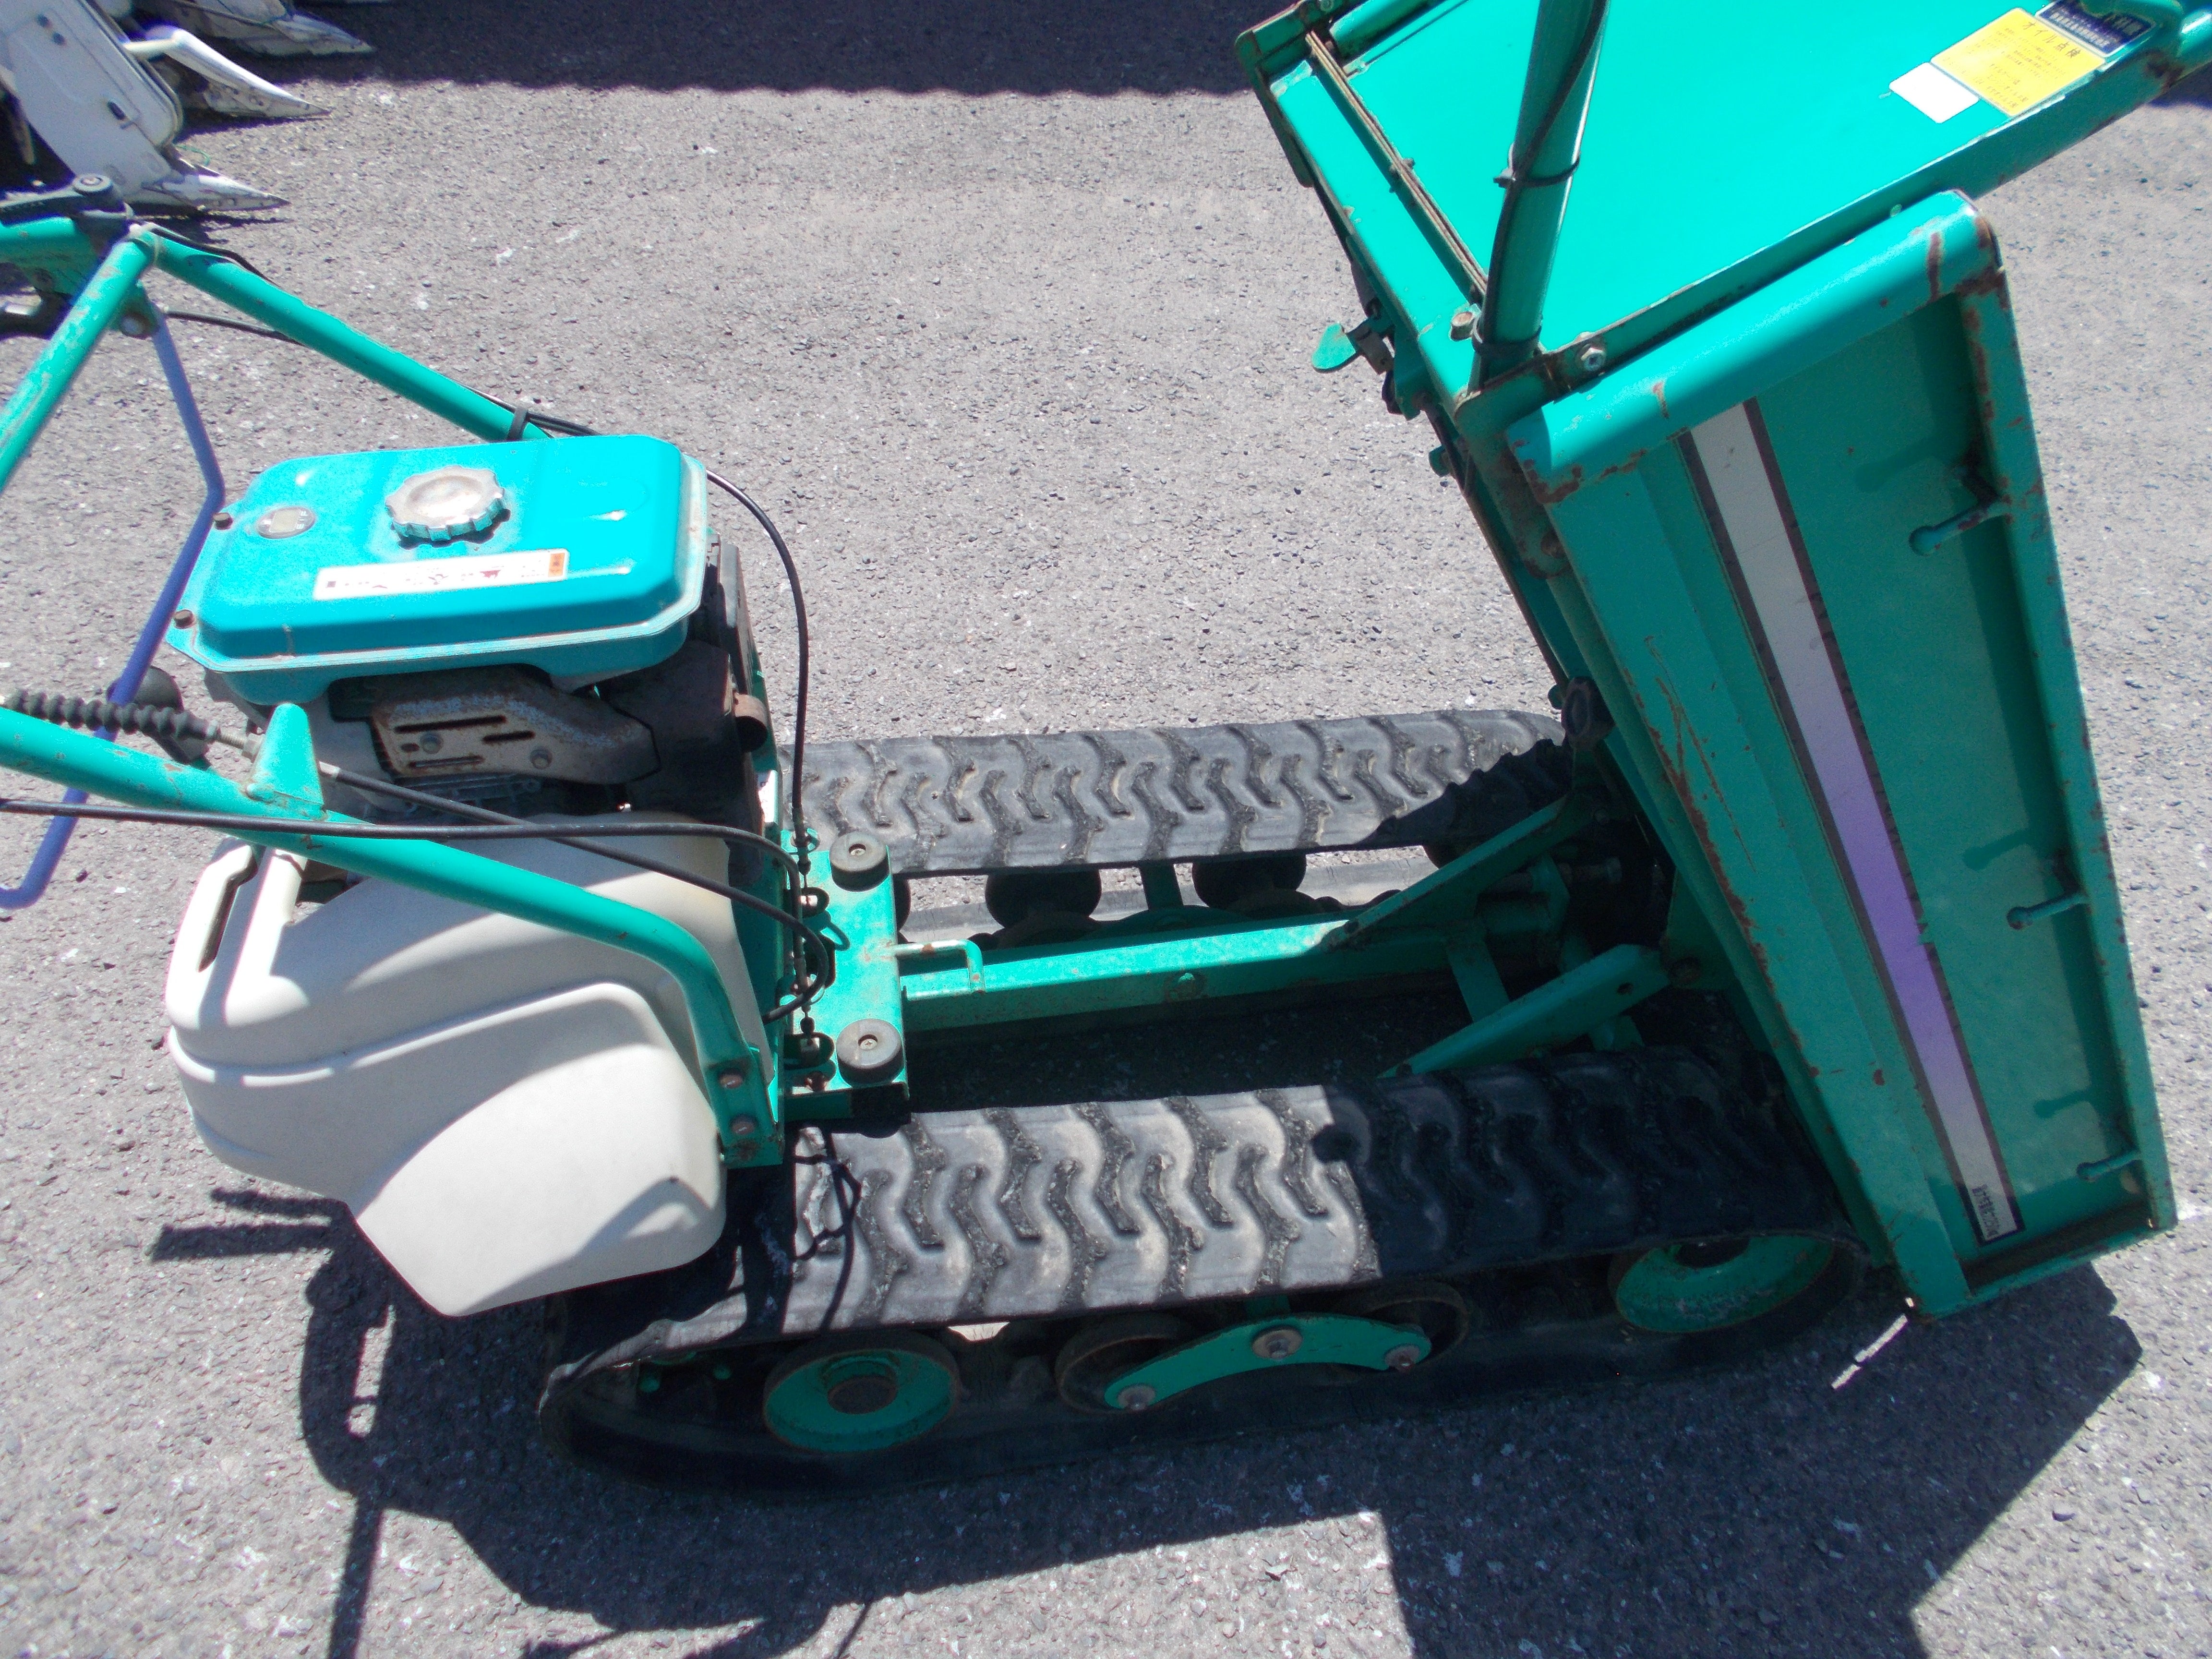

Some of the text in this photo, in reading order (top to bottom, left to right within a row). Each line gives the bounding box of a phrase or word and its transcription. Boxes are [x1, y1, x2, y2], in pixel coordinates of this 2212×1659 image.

[2022, 21, 2081, 59] オイル点検
